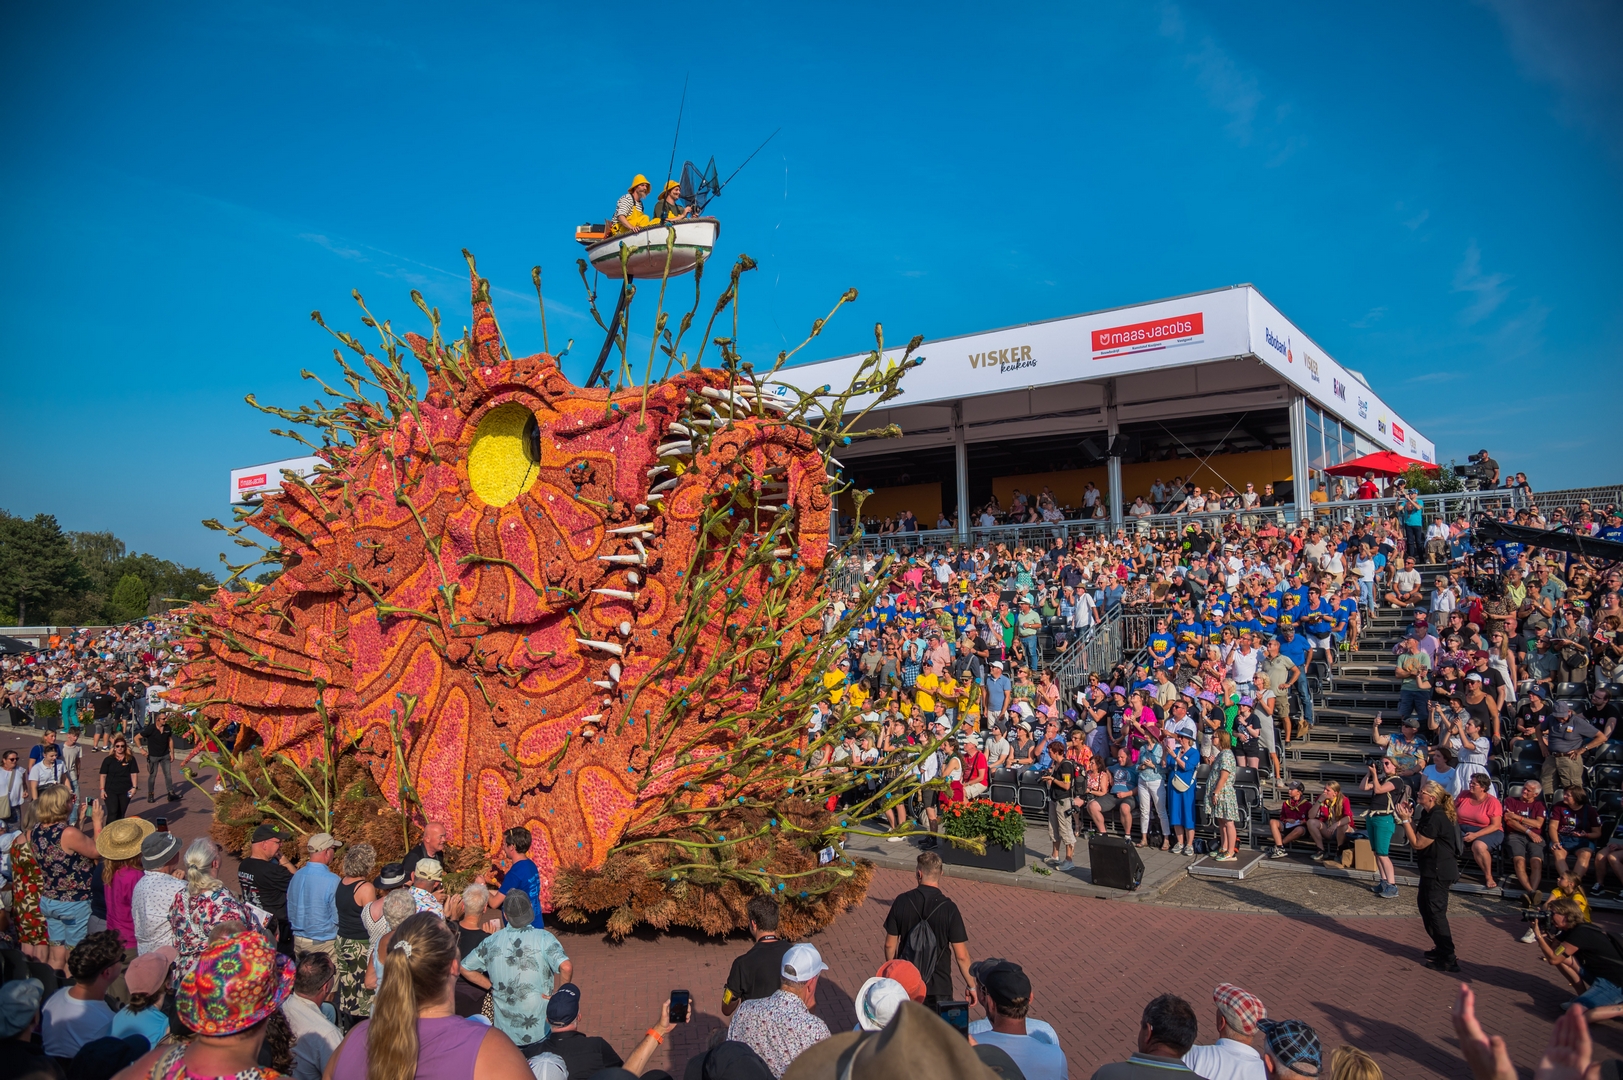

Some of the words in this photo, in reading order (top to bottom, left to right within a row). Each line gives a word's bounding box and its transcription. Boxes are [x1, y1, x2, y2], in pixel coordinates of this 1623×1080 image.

[1265, 327, 1287, 357] Rabobank
[968, 345, 1032, 369] VISKER
[1000, 357, 1038, 374] keukens
